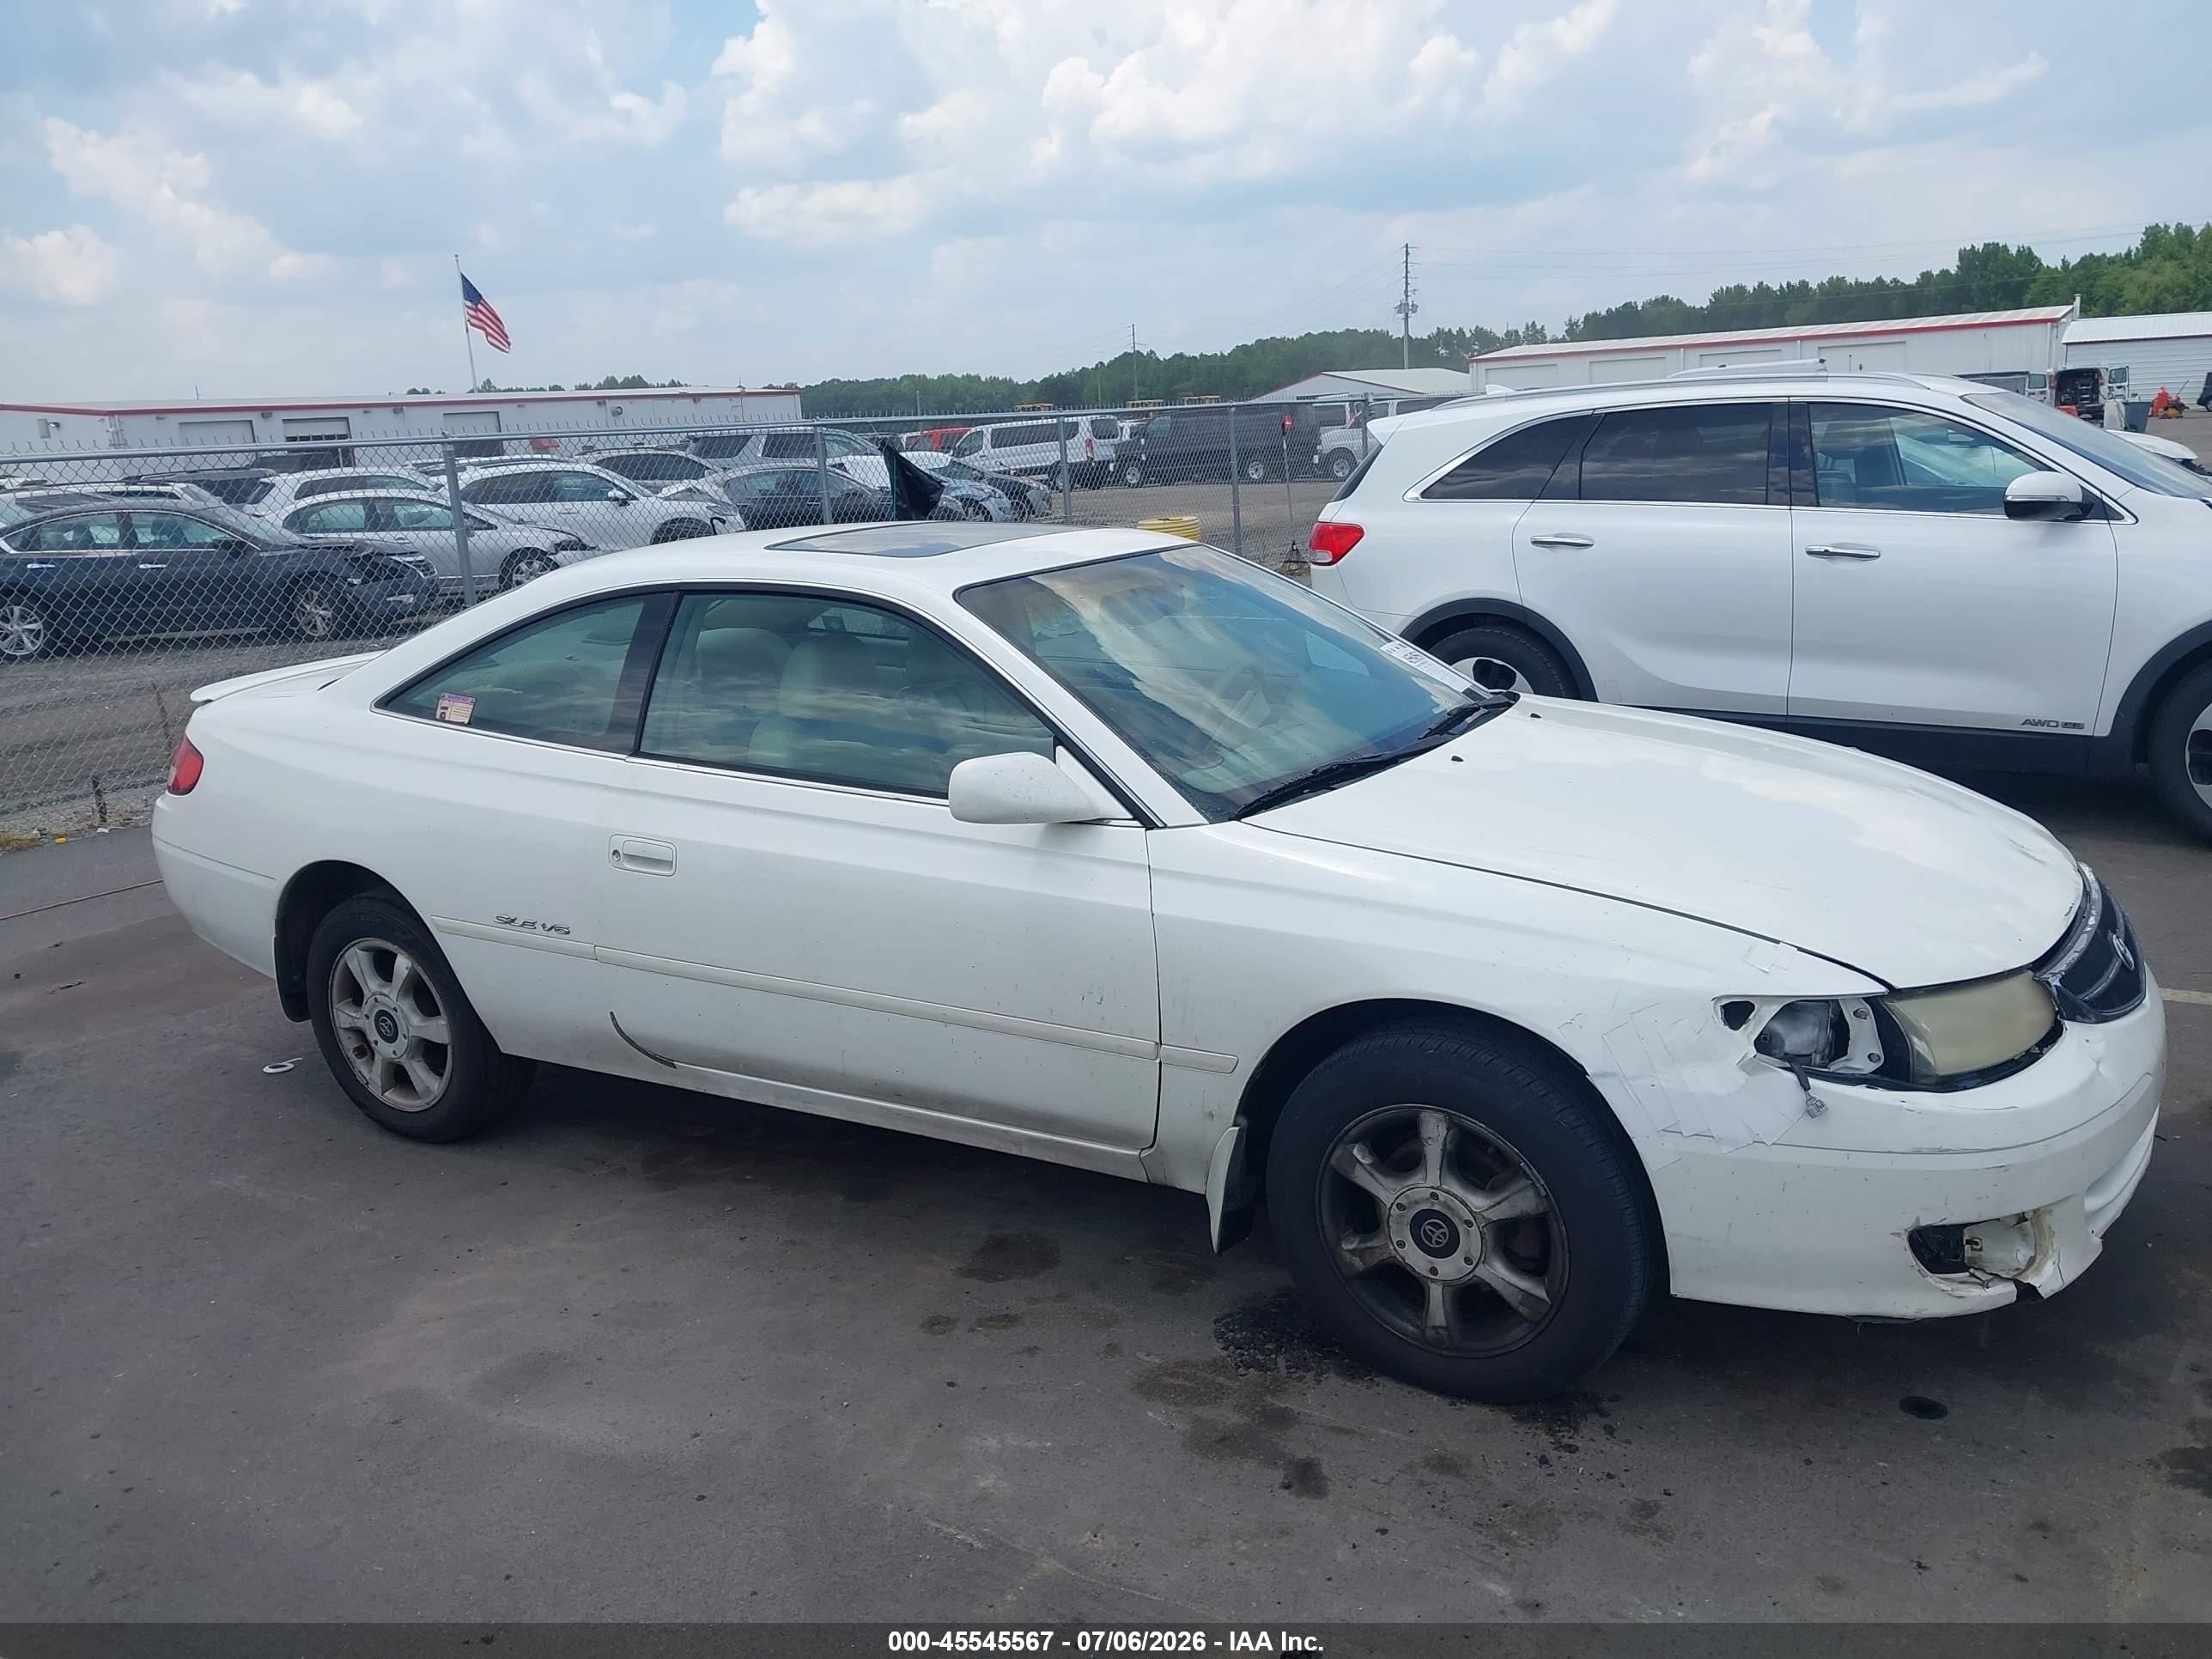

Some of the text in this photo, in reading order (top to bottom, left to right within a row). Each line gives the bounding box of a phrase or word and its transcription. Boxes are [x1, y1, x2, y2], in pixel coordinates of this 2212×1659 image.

[2021, 718, 2060, 728] AWD
[493, 915, 571, 935] SLE V6
